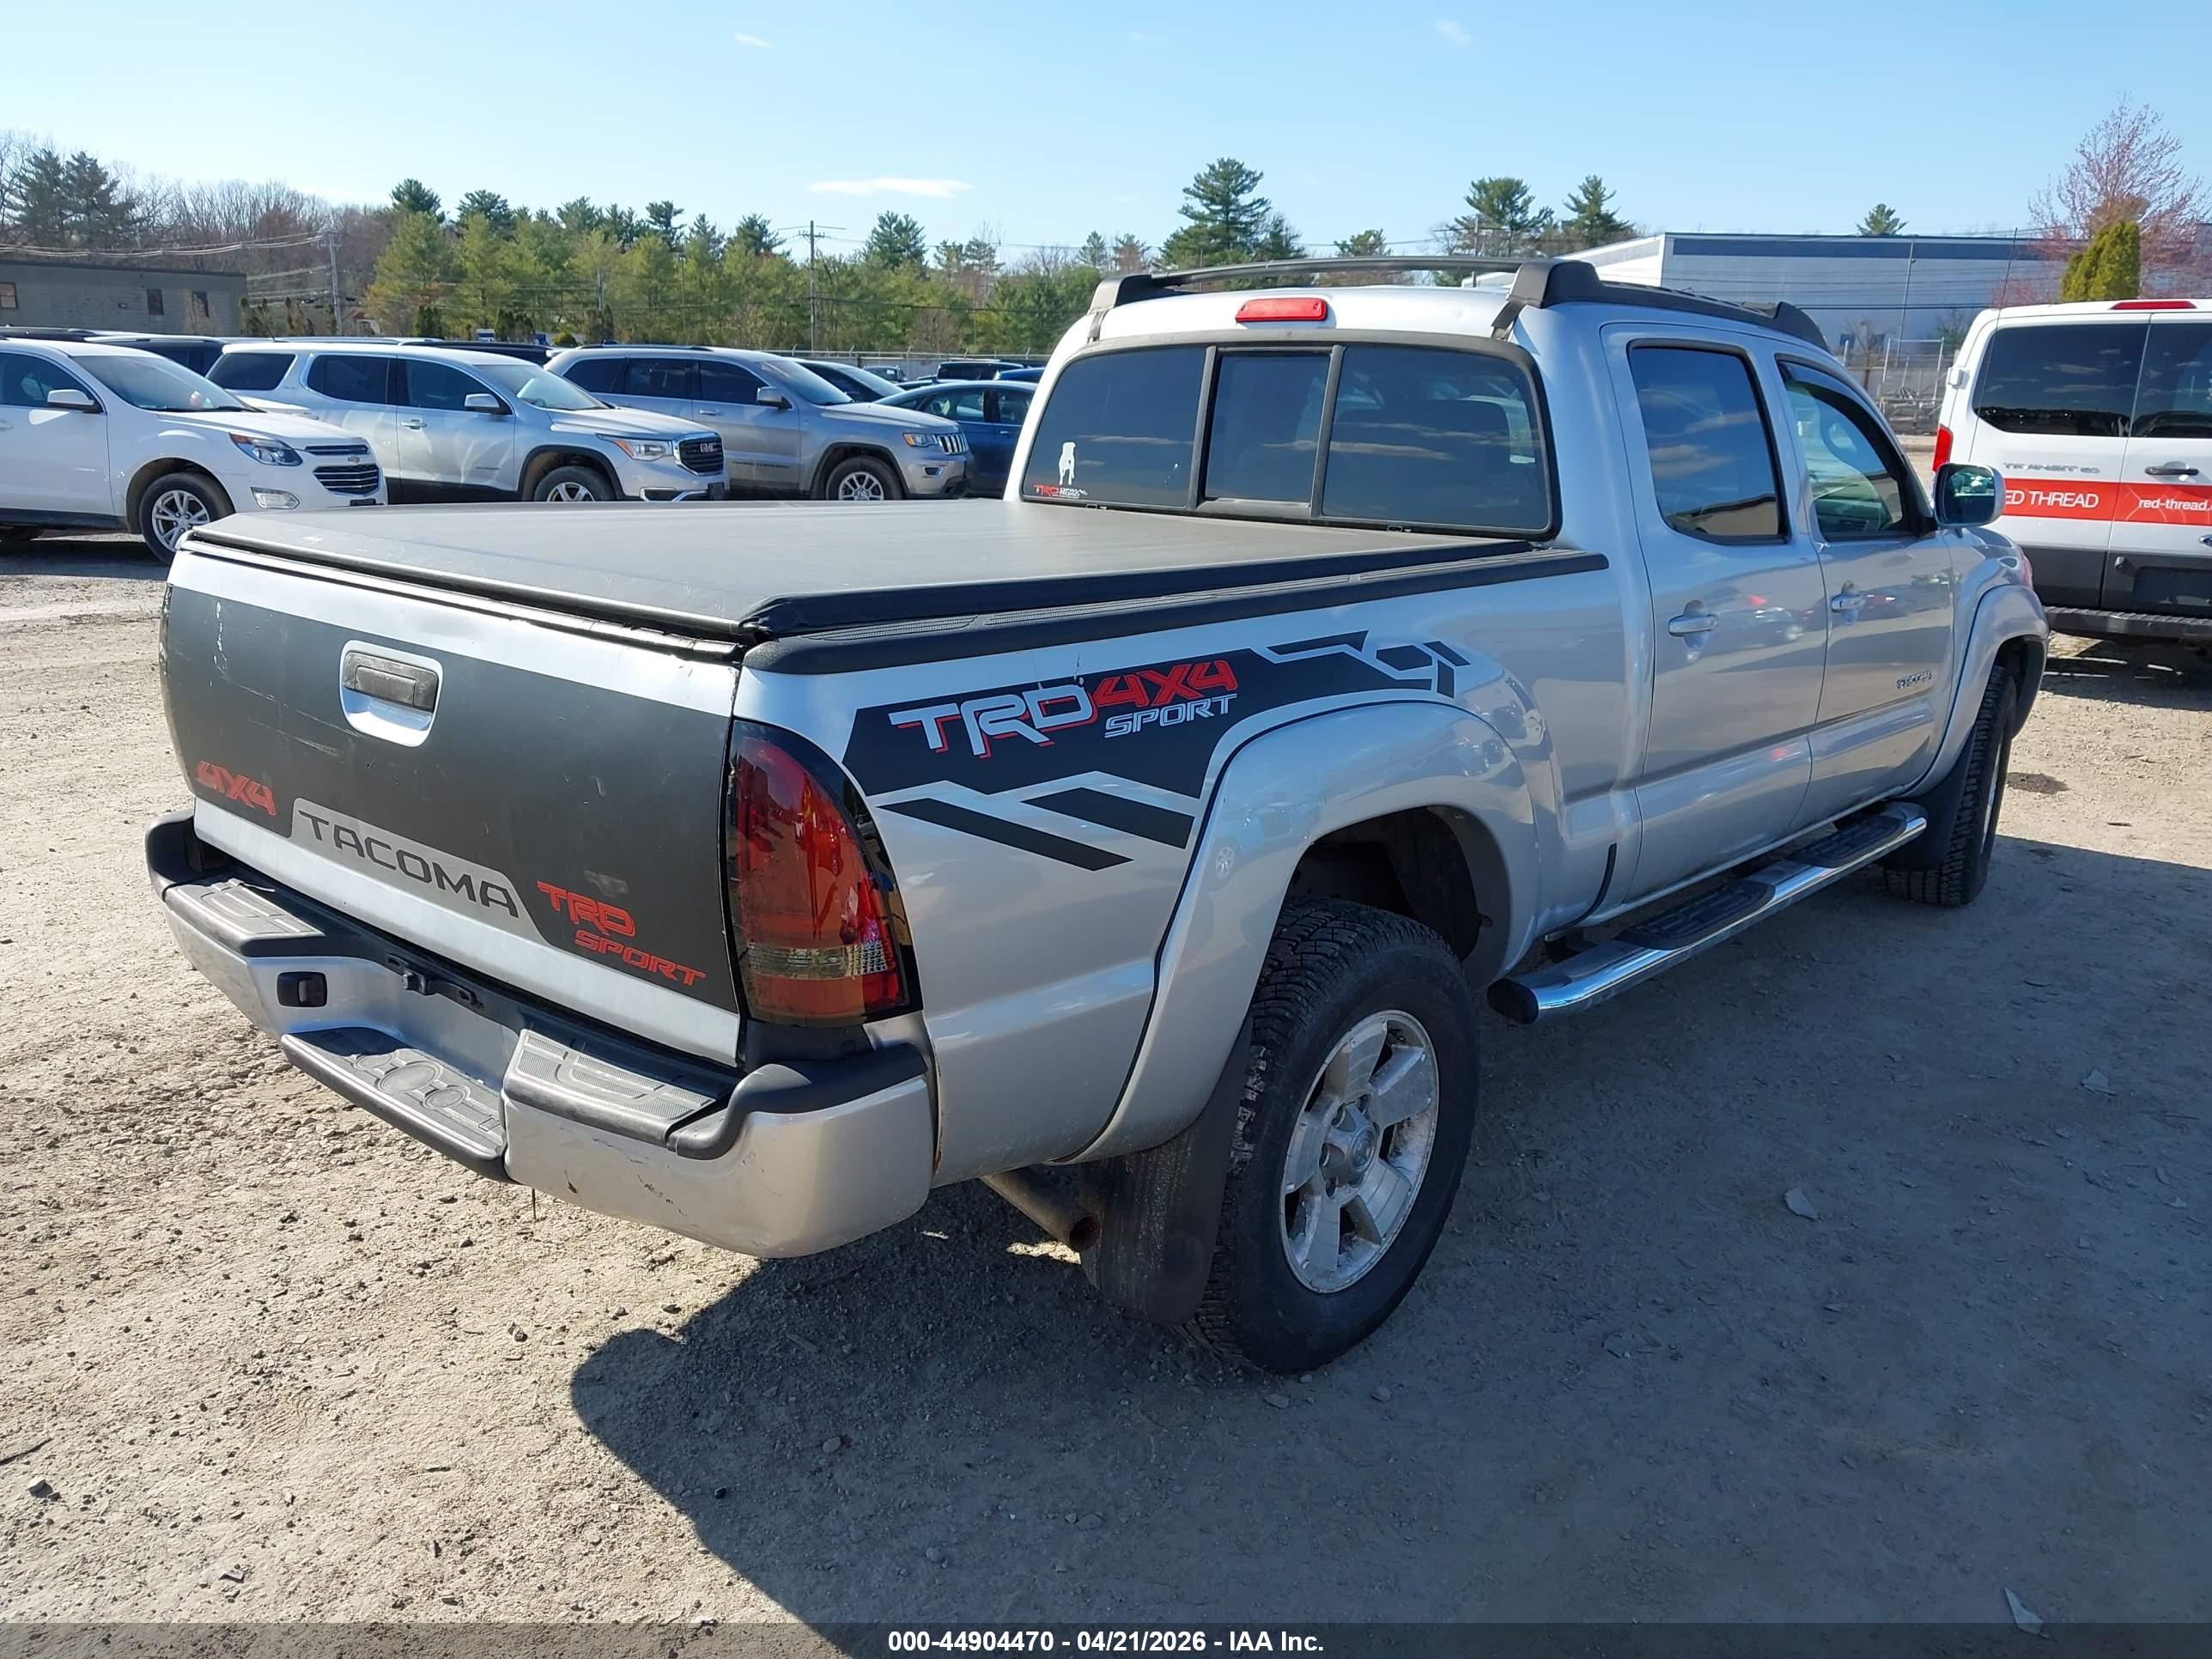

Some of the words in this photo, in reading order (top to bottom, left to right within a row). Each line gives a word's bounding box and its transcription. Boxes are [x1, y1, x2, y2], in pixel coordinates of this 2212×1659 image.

[1033, 484, 1059, 496] TRD
[2006, 489, 2026, 505] ED
[2028, 490, 2100, 508] THREAD
[2139, 498, 2212, 511] red-thread.
[888, 684, 1098, 759] TRD
[1104, 693, 1237, 738] SPORT
[299, 810, 520, 918] TACOMA
[537, 880, 636, 938] TRD
[575, 930, 707, 987] SPORT
